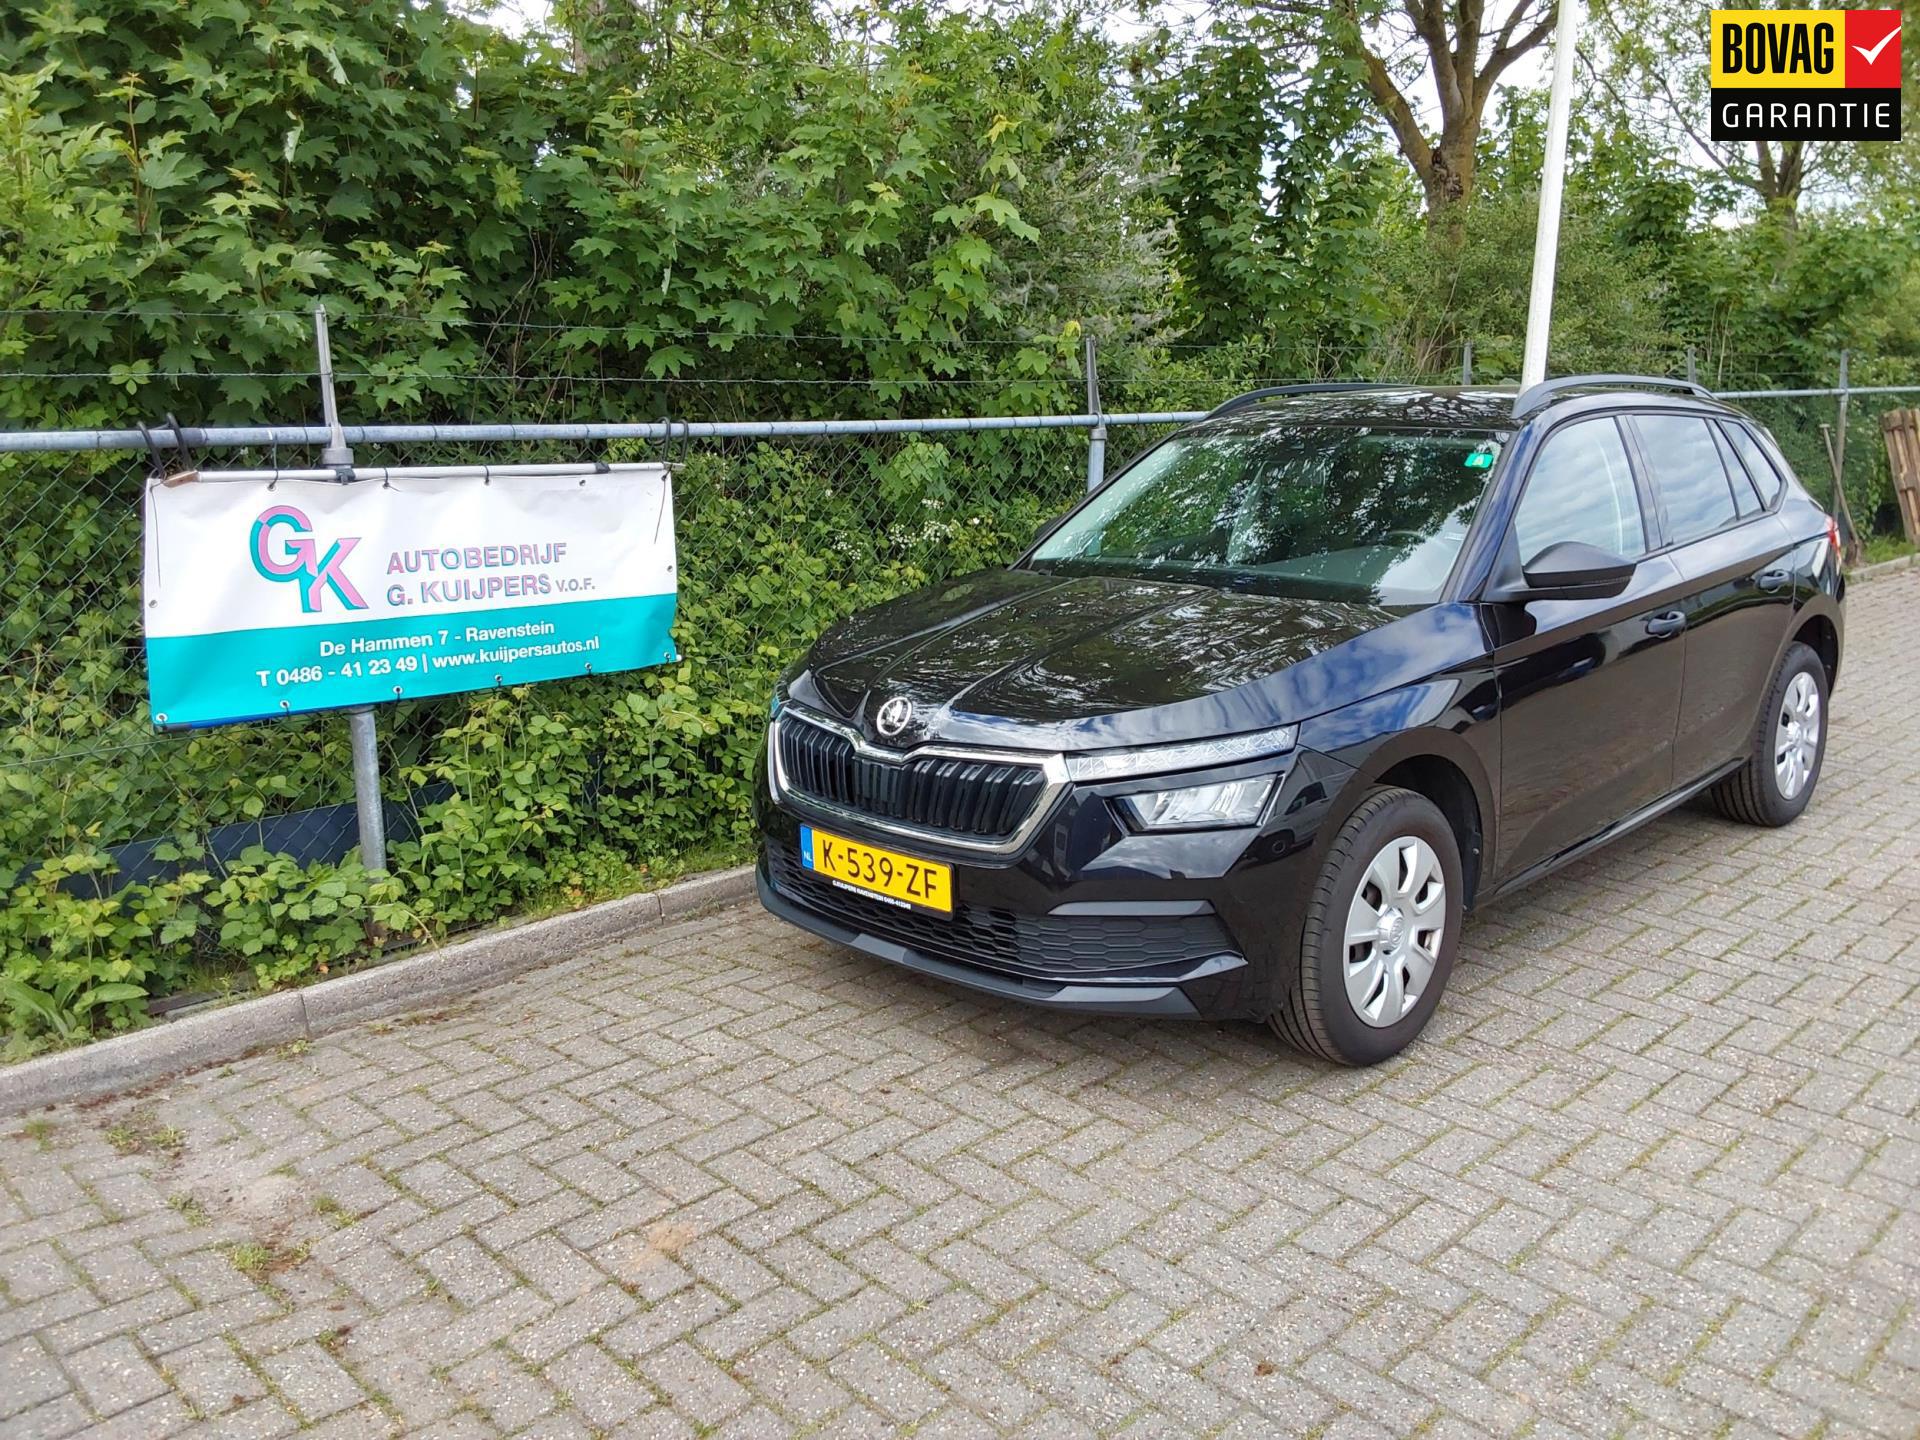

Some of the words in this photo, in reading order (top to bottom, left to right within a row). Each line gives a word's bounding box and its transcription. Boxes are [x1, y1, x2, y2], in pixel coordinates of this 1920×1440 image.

[249, 504, 370, 613] GK
[387, 542, 567, 574] AUTOBEDRIJF
[386, 584, 413, 606] G.
[420, 573, 551, 603] KUIJPERS
[555, 578, 596, 593] V.O.F.
[319, 641, 346, 657] De
[351, 634, 433, 653] Hammen
[438, 630, 449, 645] 7
[466, 621, 555, 642] Ravenstein
[256, 670, 270, 687] T
[276, 666, 323, 686] 0486
[340, 661, 362, 678] 41
[367, 659, 391, 675] 23
[395, 656, 418, 672] 49
[432, 636, 600, 668] www.kuijpersautos.nl
[822, 839, 937, 899] K-539-ZF
